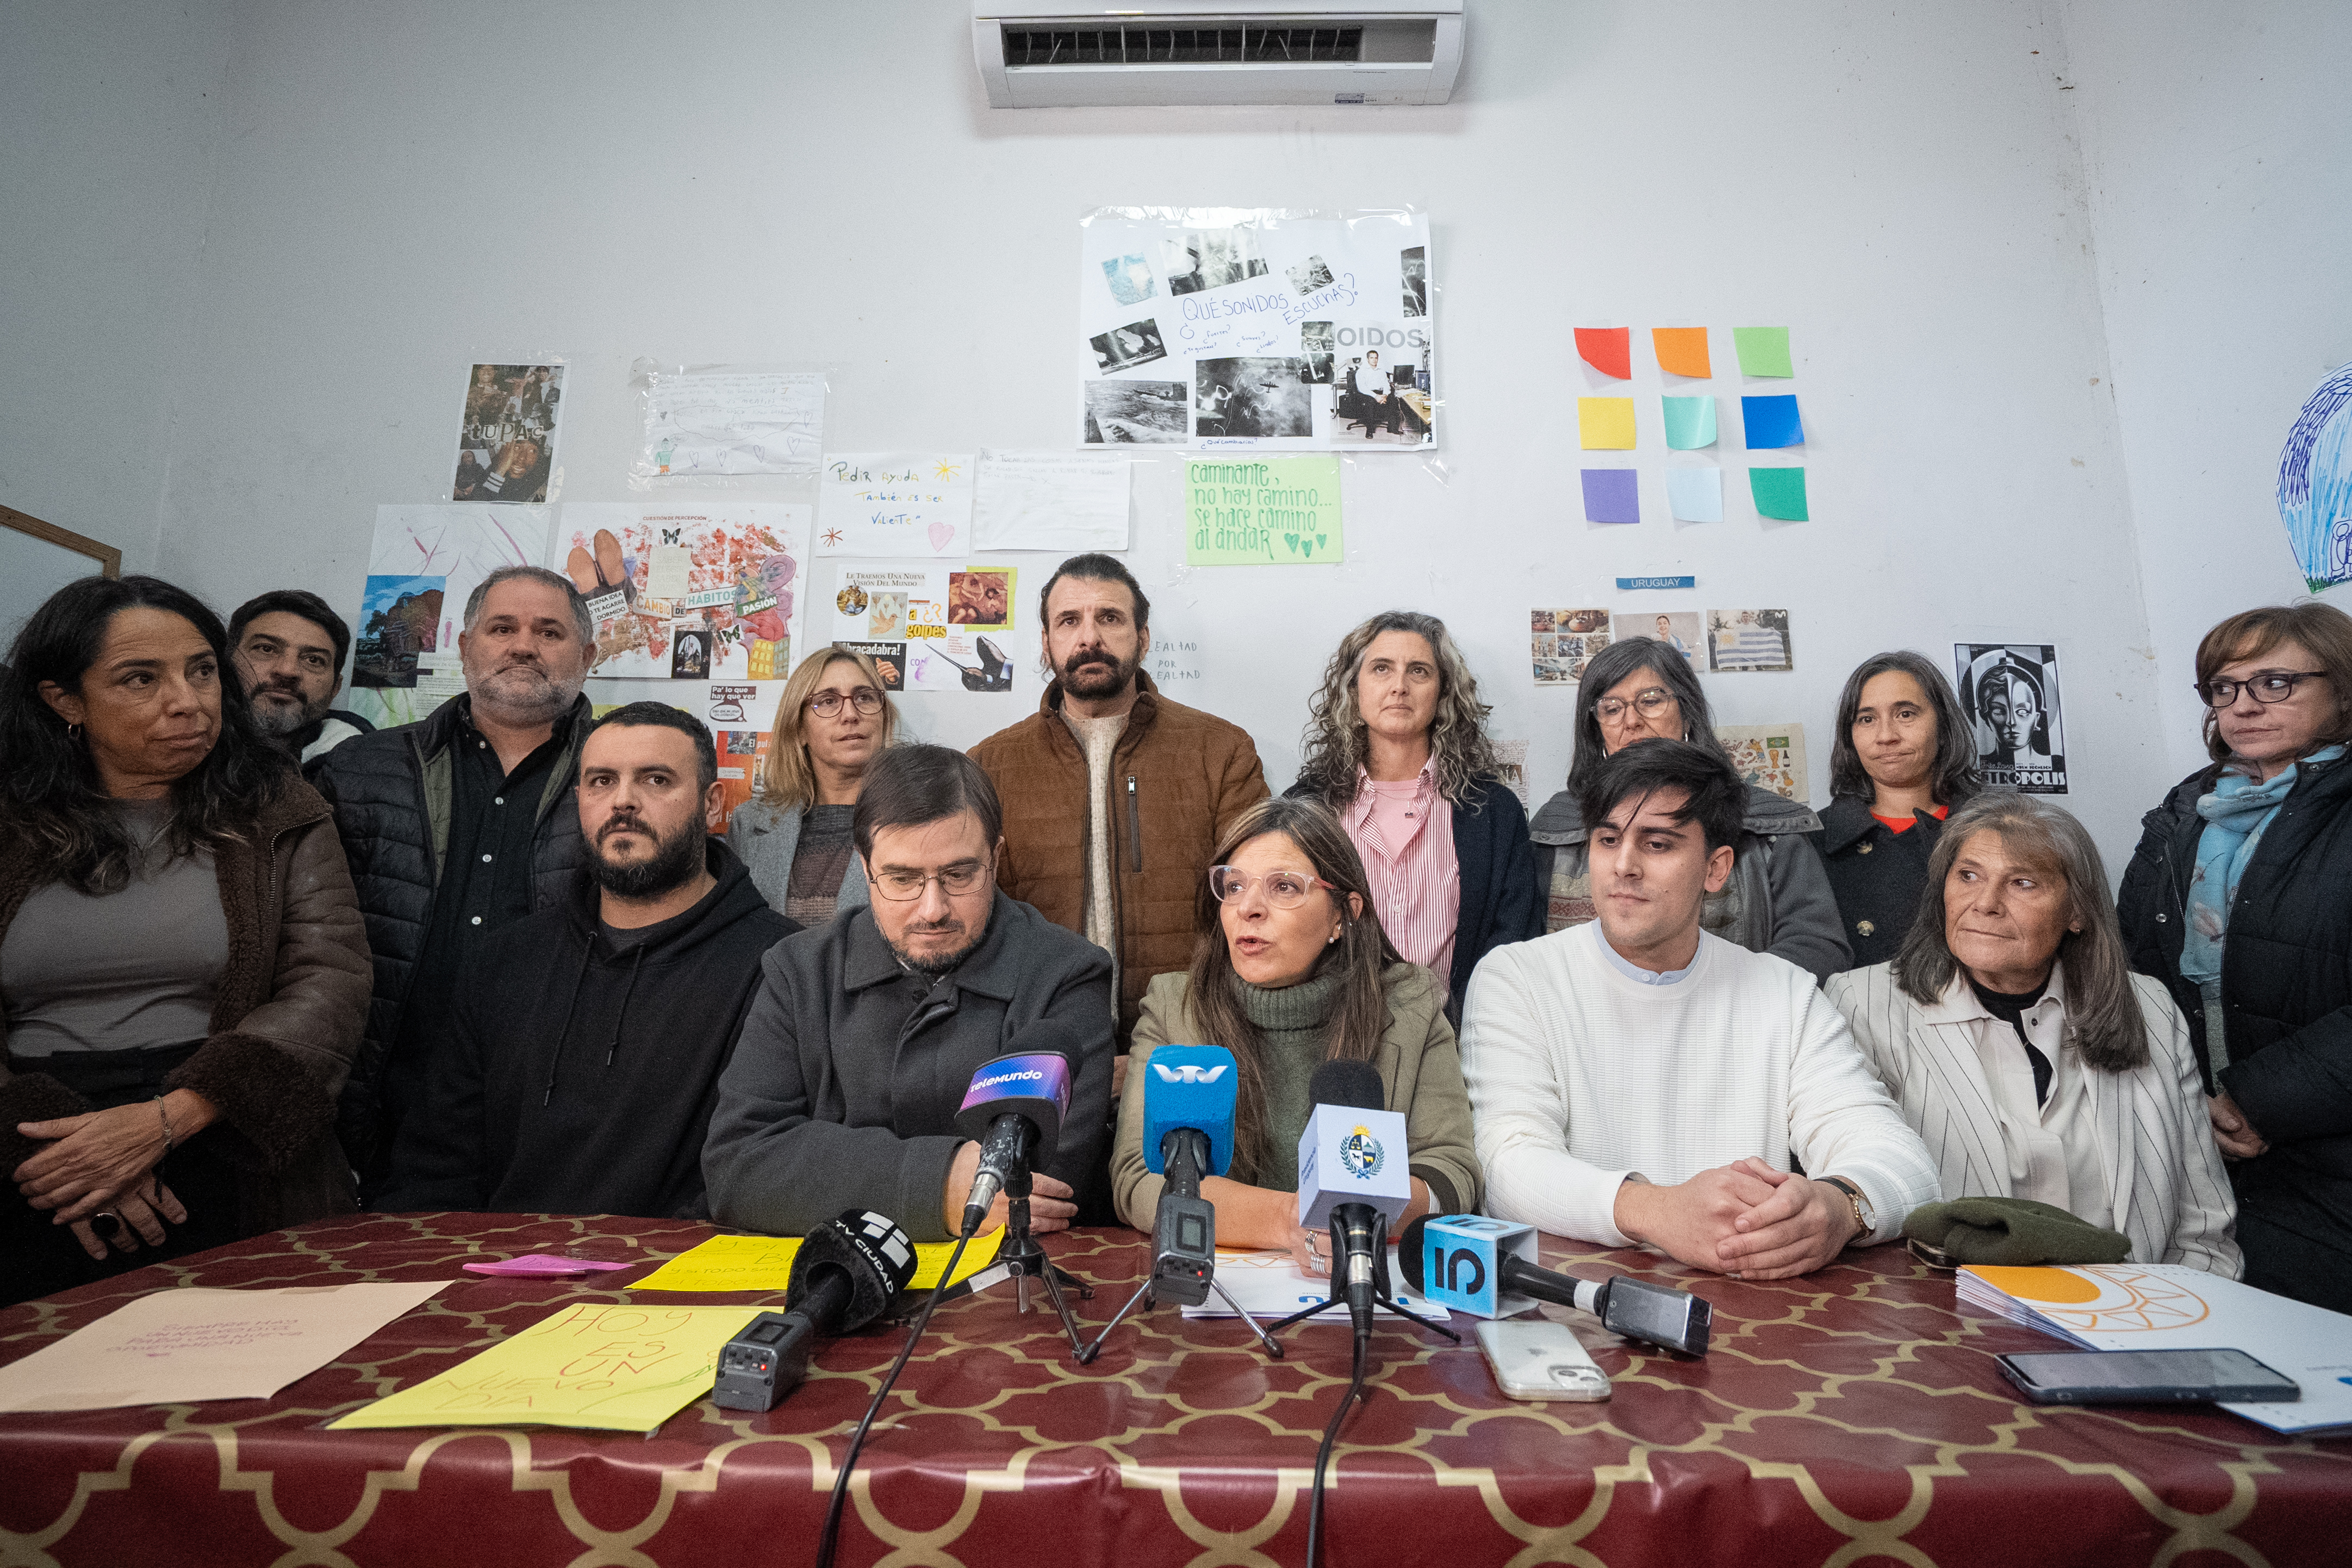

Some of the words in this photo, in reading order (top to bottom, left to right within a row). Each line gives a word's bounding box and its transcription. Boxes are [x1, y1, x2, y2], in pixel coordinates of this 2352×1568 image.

[1222, 293, 1289, 316] SONIDOS
[1337, 327, 1423, 348] OIDOS
[1194, 488, 1216, 505] no
[1222, 487, 1251, 506] hay
[1215, 507, 1252, 528] hace
[1258, 507, 1317, 532] camino
[1194, 527, 1210, 550] al
[1632, 578, 1681, 588] URUGUAY
[588, 596, 608, 608] BUENA
[609, 592, 623, 601] IDEA
[602, 599, 625, 611] AGARRE
[636, 595, 670, 615] CAMBIO
[742, 595, 778, 615] PASIÓN
[905, 624, 947, 640] golpes
[1158, 659, 1177, 668] POR
[748, 739, 756, 748] El
[836, 1219, 855, 1237] TV
[854, 1237, 895, 1295] CIUDAD
[532, 1305, 693, 1337] HOY
[585, 1340, 667, 1359] ES
[559, 1352, 683, 1378] UN
[432, 1368, 614, 1391] NUEVO
